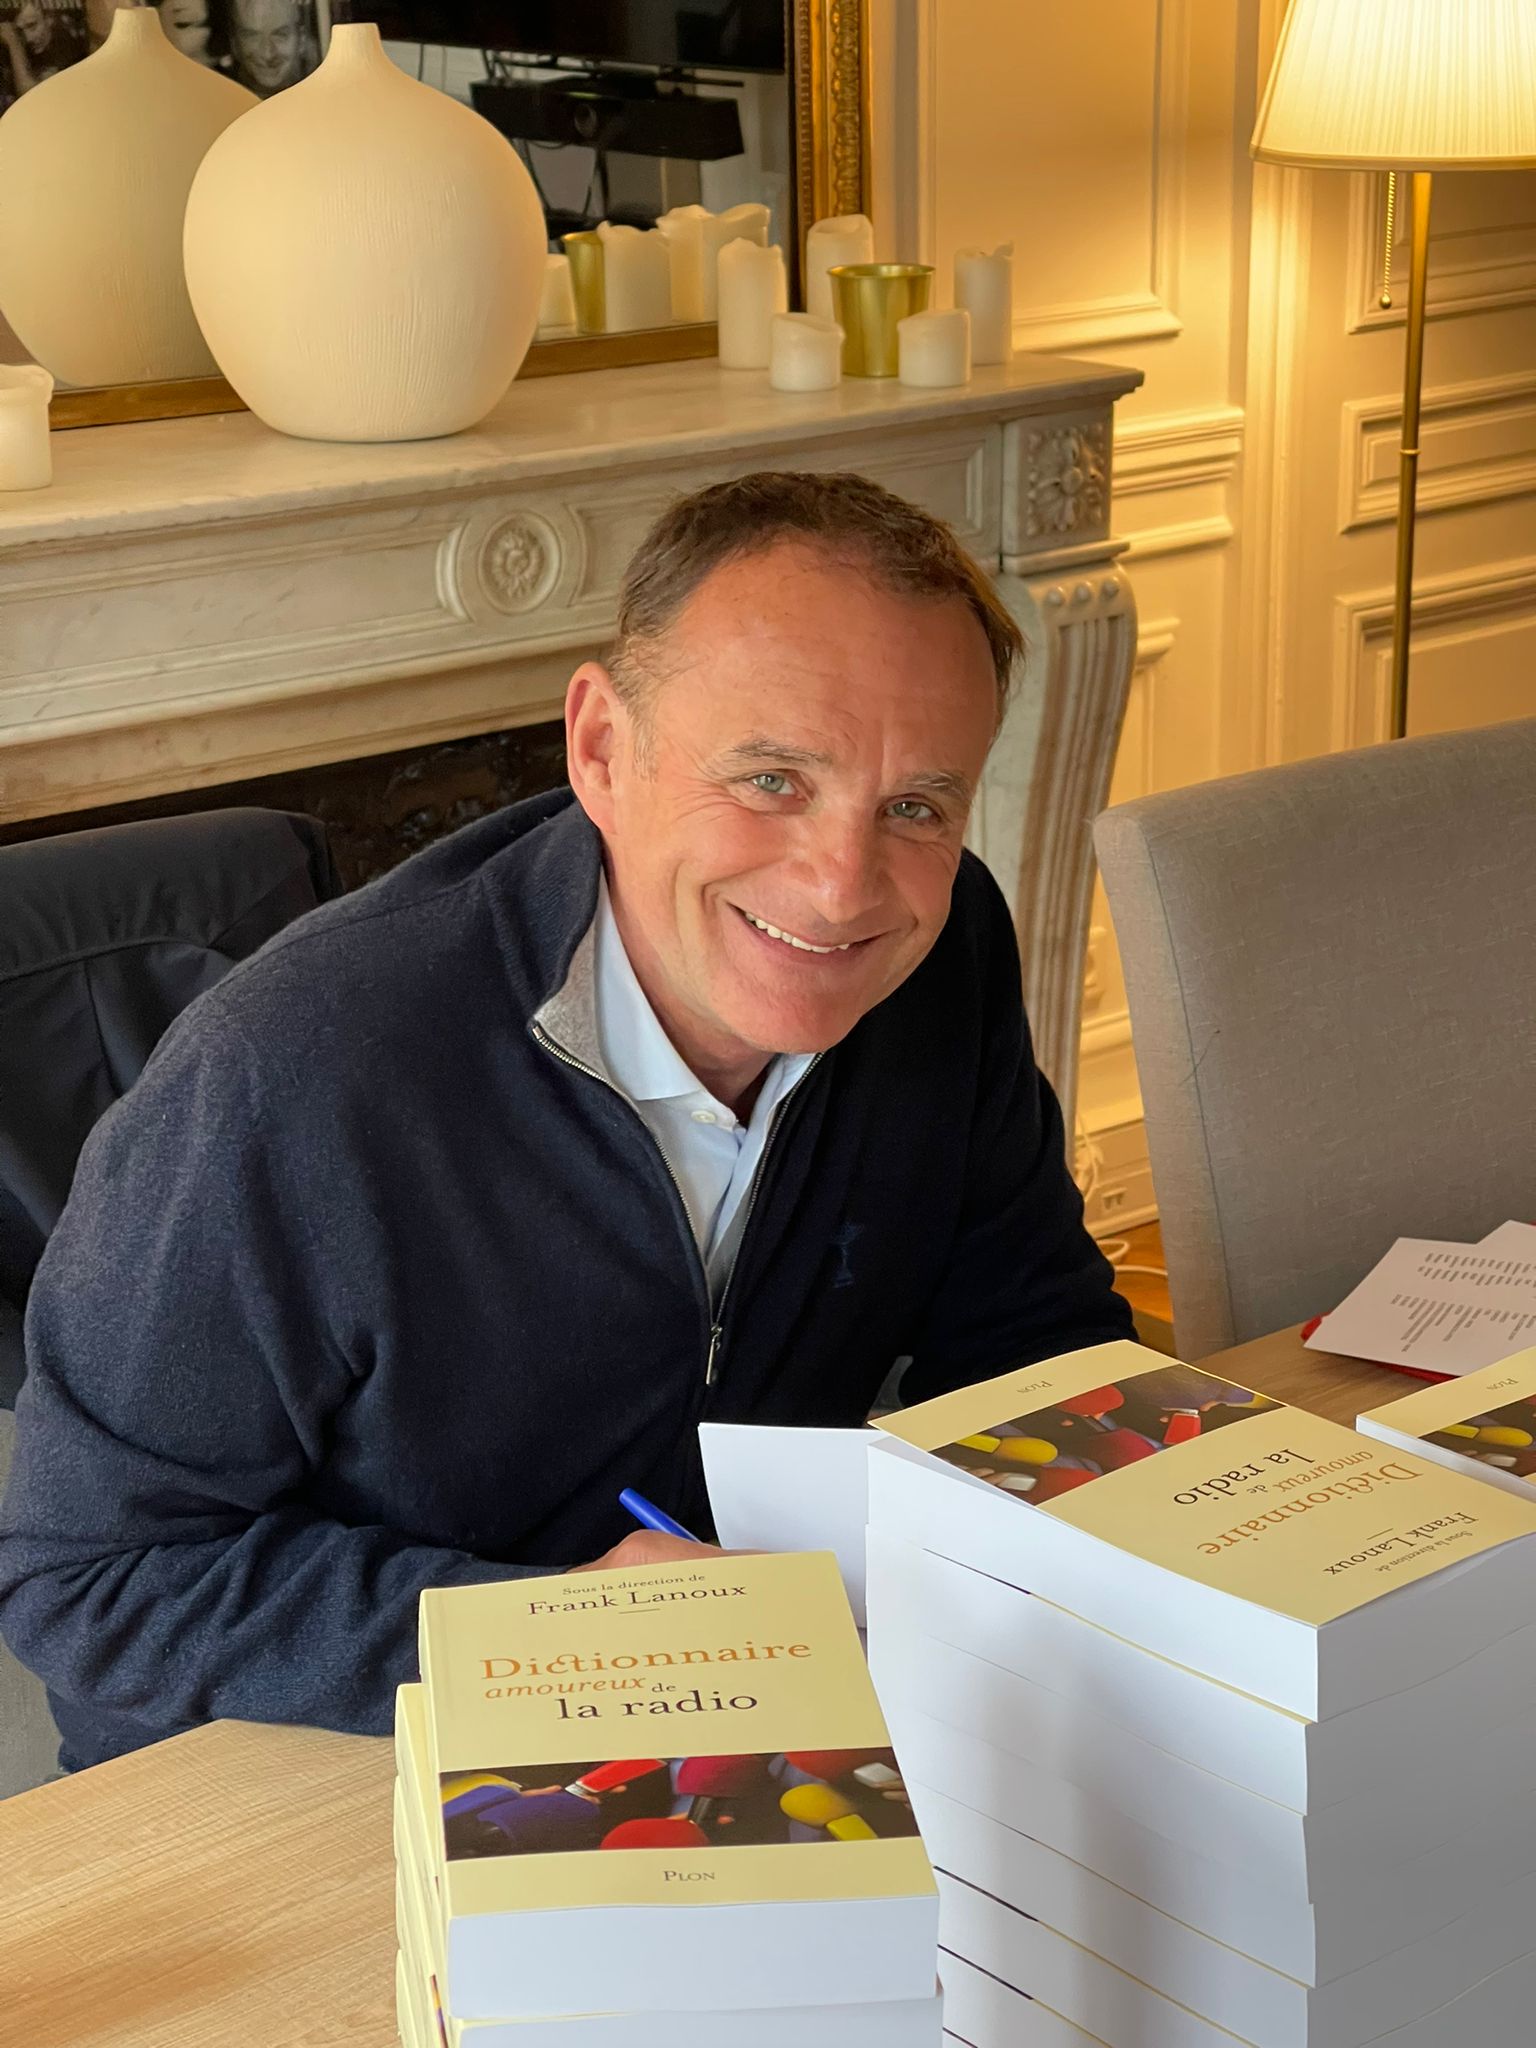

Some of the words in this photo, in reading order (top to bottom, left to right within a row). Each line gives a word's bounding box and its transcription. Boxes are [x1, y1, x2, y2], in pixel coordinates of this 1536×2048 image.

[1263, 1448, 1316, 1466] la
[1271, 1450, 1374, 1493] amoureux
[1173, 1463, 1266, 1505] radio
[1246, 1484, 1268, 1494] de
[1196, 1462, 1424, 1555] Dictionnaire
[1405, 1512, 1479, 1539] Frank
[1323, 1537, 1416, 1575] Lanoux
[1389, 1545, 1437, 1566] direction
[528, 1594, 619, 1615] Frank
[628, 1584, 748, 1605] Lanoux
[562, 1586, 597, 1596] Sous
[601, 1583, 614, 1591] la
[618, 1576, 685, 1590] direction
[688, 1573, 706, 1582] de
[479, 1641, 813, 1680] Dictionnaire
[484, 1676, 647, 1700] amoureux
[651, 1682, 677, 1693] de
[554, 1698, 602, 1721] la
[620, 1689, 759, 1717] radio
